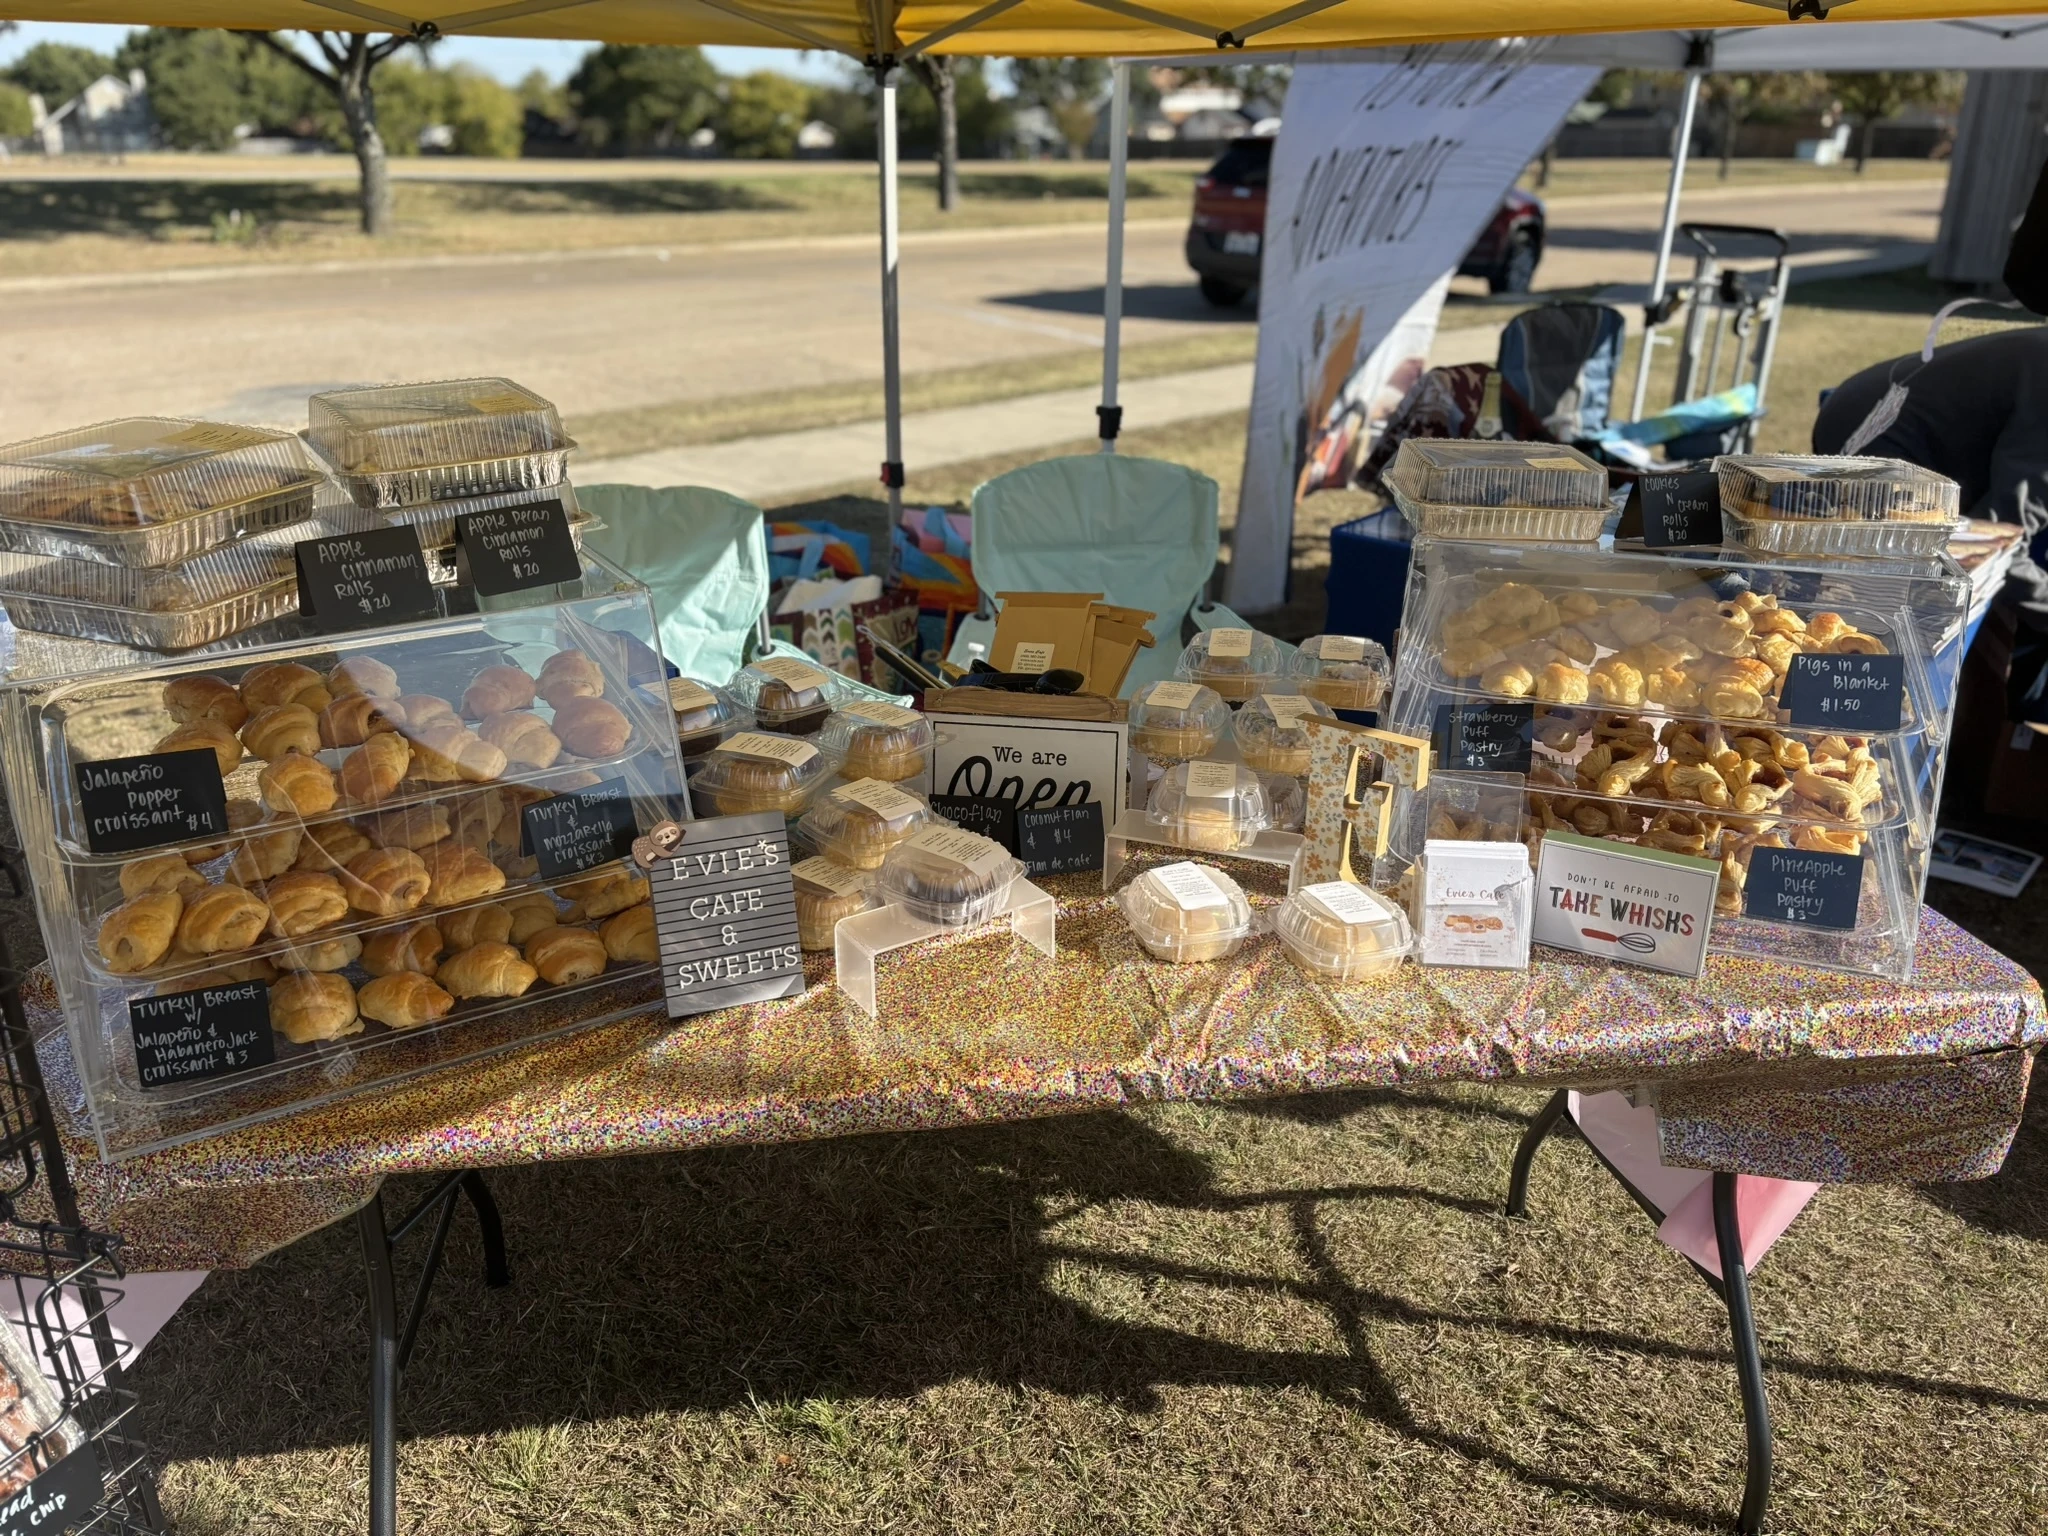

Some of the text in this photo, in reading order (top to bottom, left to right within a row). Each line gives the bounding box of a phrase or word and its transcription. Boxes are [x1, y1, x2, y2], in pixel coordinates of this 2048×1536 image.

[1666, 492, 1674, 505] N
[1668, 527, 1687, 543] $20
[499, 545, 531, 562] Rolls
[512, 562, 540, 579] $20
[334, 580, 374, 600] Rolls
[358, 593, 391, 614] $20
[1797, 656, 1871, 677] Pigs in a
[1833, 674, 1890, 690] Blanket
[1820, 697, 1861, 712] $1.50
[992, 746, 1068, 766] We are
[1466, 754, 1485, 767] $3
[82, 764, 164, 791] Jalapeño
[528, 799, 579, 822] Turkey
[1063, 809, 1089, 821] Flan
[186, 812, 213, 831] $4
[1051, 857, 1064, 870] de
[1446, 887, 1475, 899] Evie's
[1567, 872, 1680, 903] DON'T BE AFRAID TO
[689, 888, 764, 921] CAFE
[1549, 886, 1695, 937] TAKE WHISKS
[1786, 907, 1806, 920] $3
[721, 924, 738, 946] &
[678, 945, 799, 989] SWEETS
[133, 995, 195, 1019] Turkey
[185, 1008, 201, 1024] w/
[136, 1026, 201, 1049] Jalapeño
